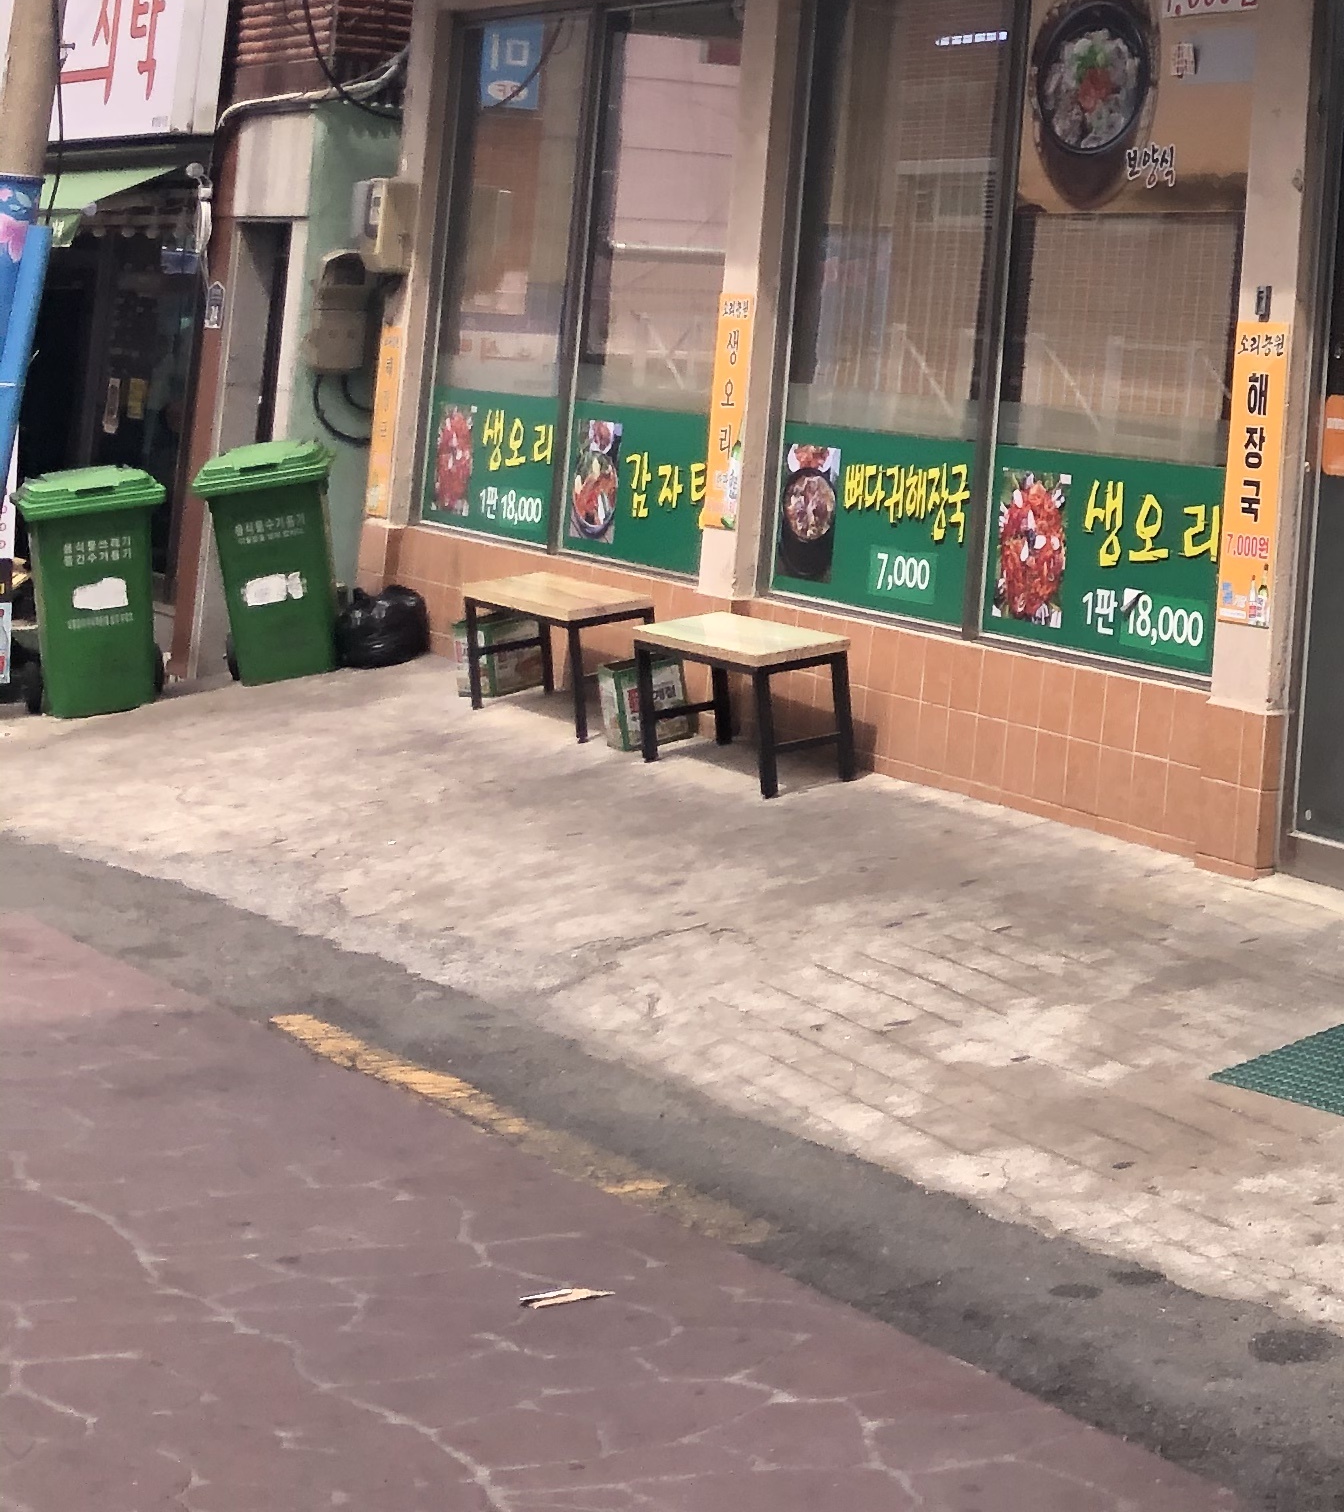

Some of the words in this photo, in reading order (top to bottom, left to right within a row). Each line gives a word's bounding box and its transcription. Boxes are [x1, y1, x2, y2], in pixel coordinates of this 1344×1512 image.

[1126, 142, 1175, 188] 보양식
[1238, 334, 1285, 357] 오리농원
[719, 330, 740, 460] 생오리
[482, 408, 554, 472] 생오리
[1241, 373, 1269, 523] 해장국
[479, 486, 498, 521] 1판
[500, 488, 543, 524] 18,000
[843, 462, 971, 543] 뼈다귀해장국
[1082, 478, 1221, 568] 생오리
[876, 552, 931, 591] 7,000
[1227, 533, 1270, 559] 7,000원
[1082, 587, 1119, 636] 1판
[1126, 592, 1204, 648] 18,000
